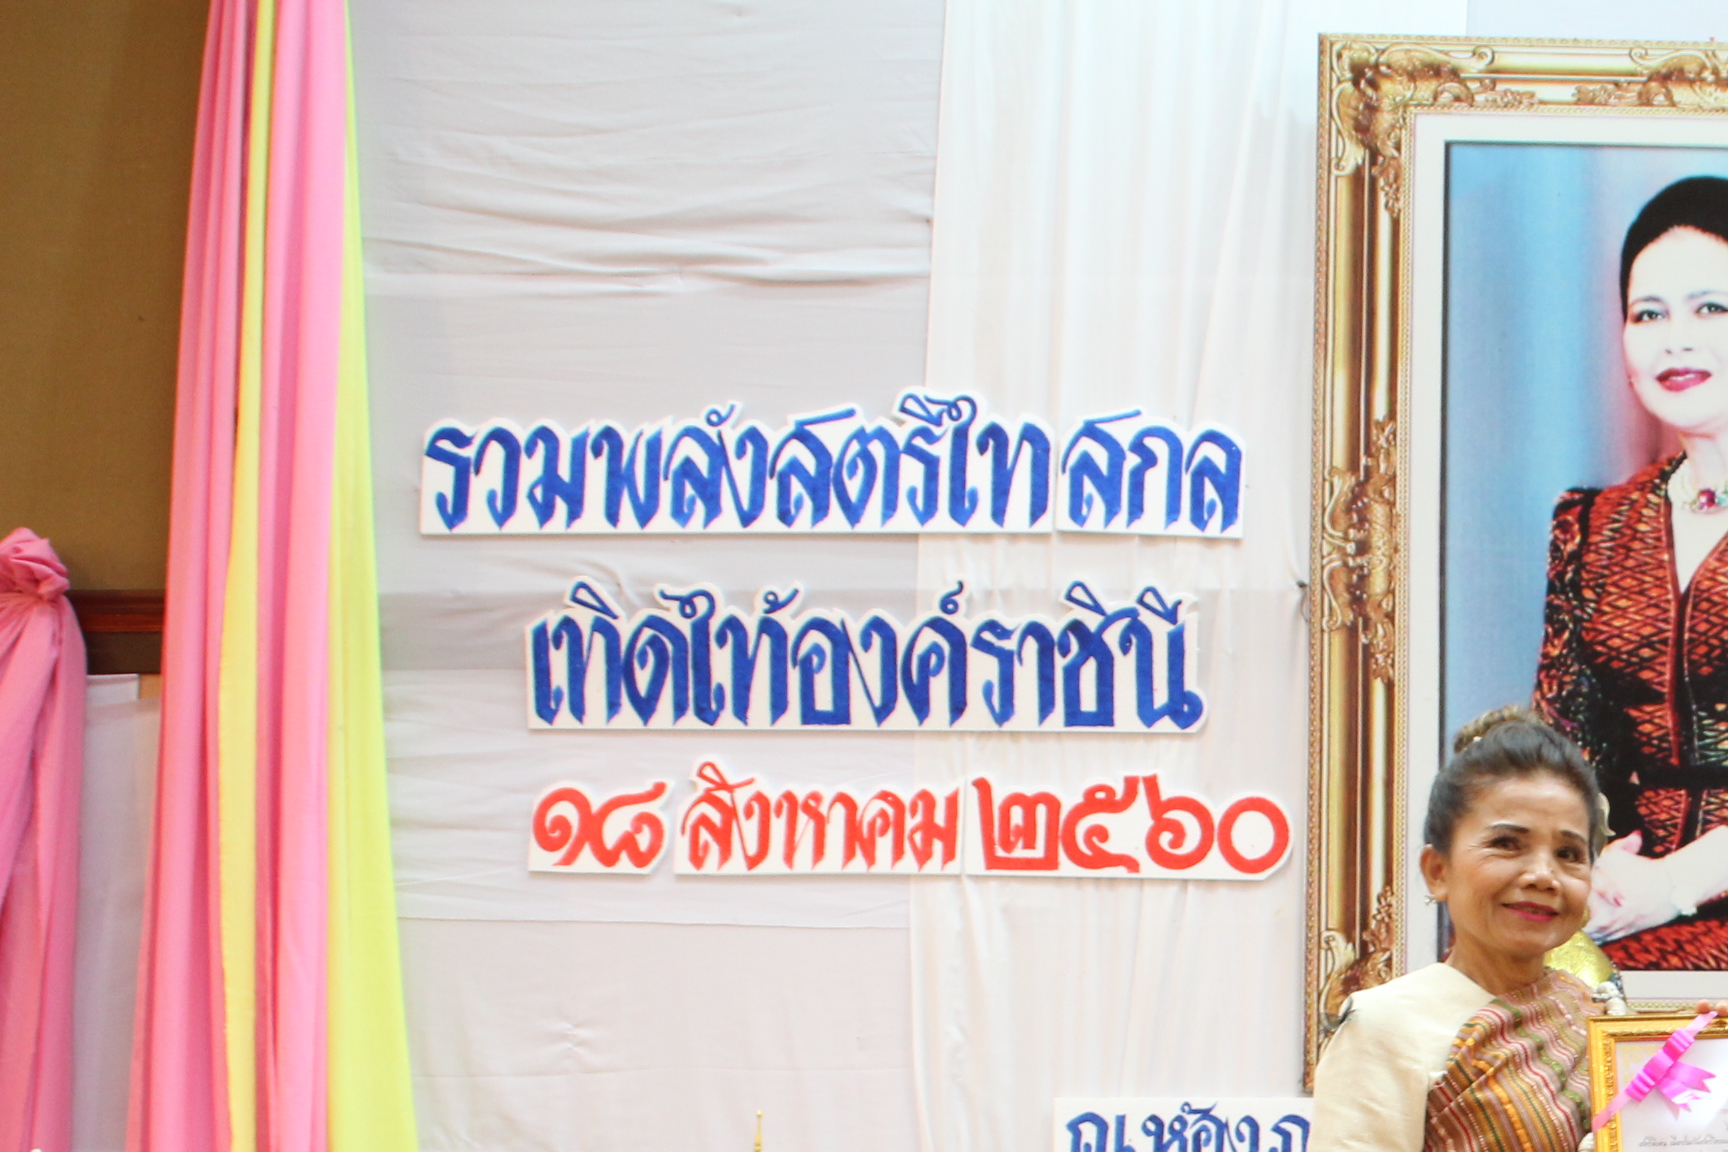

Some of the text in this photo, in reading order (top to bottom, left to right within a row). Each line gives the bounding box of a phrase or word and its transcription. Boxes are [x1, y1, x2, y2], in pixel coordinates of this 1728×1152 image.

[532, 580, 1204, 729] เทิดไท้องค์ราชินี
[533, 761, 1290, 875] ๑๘ สิงหาคม ๒๕๖๐
